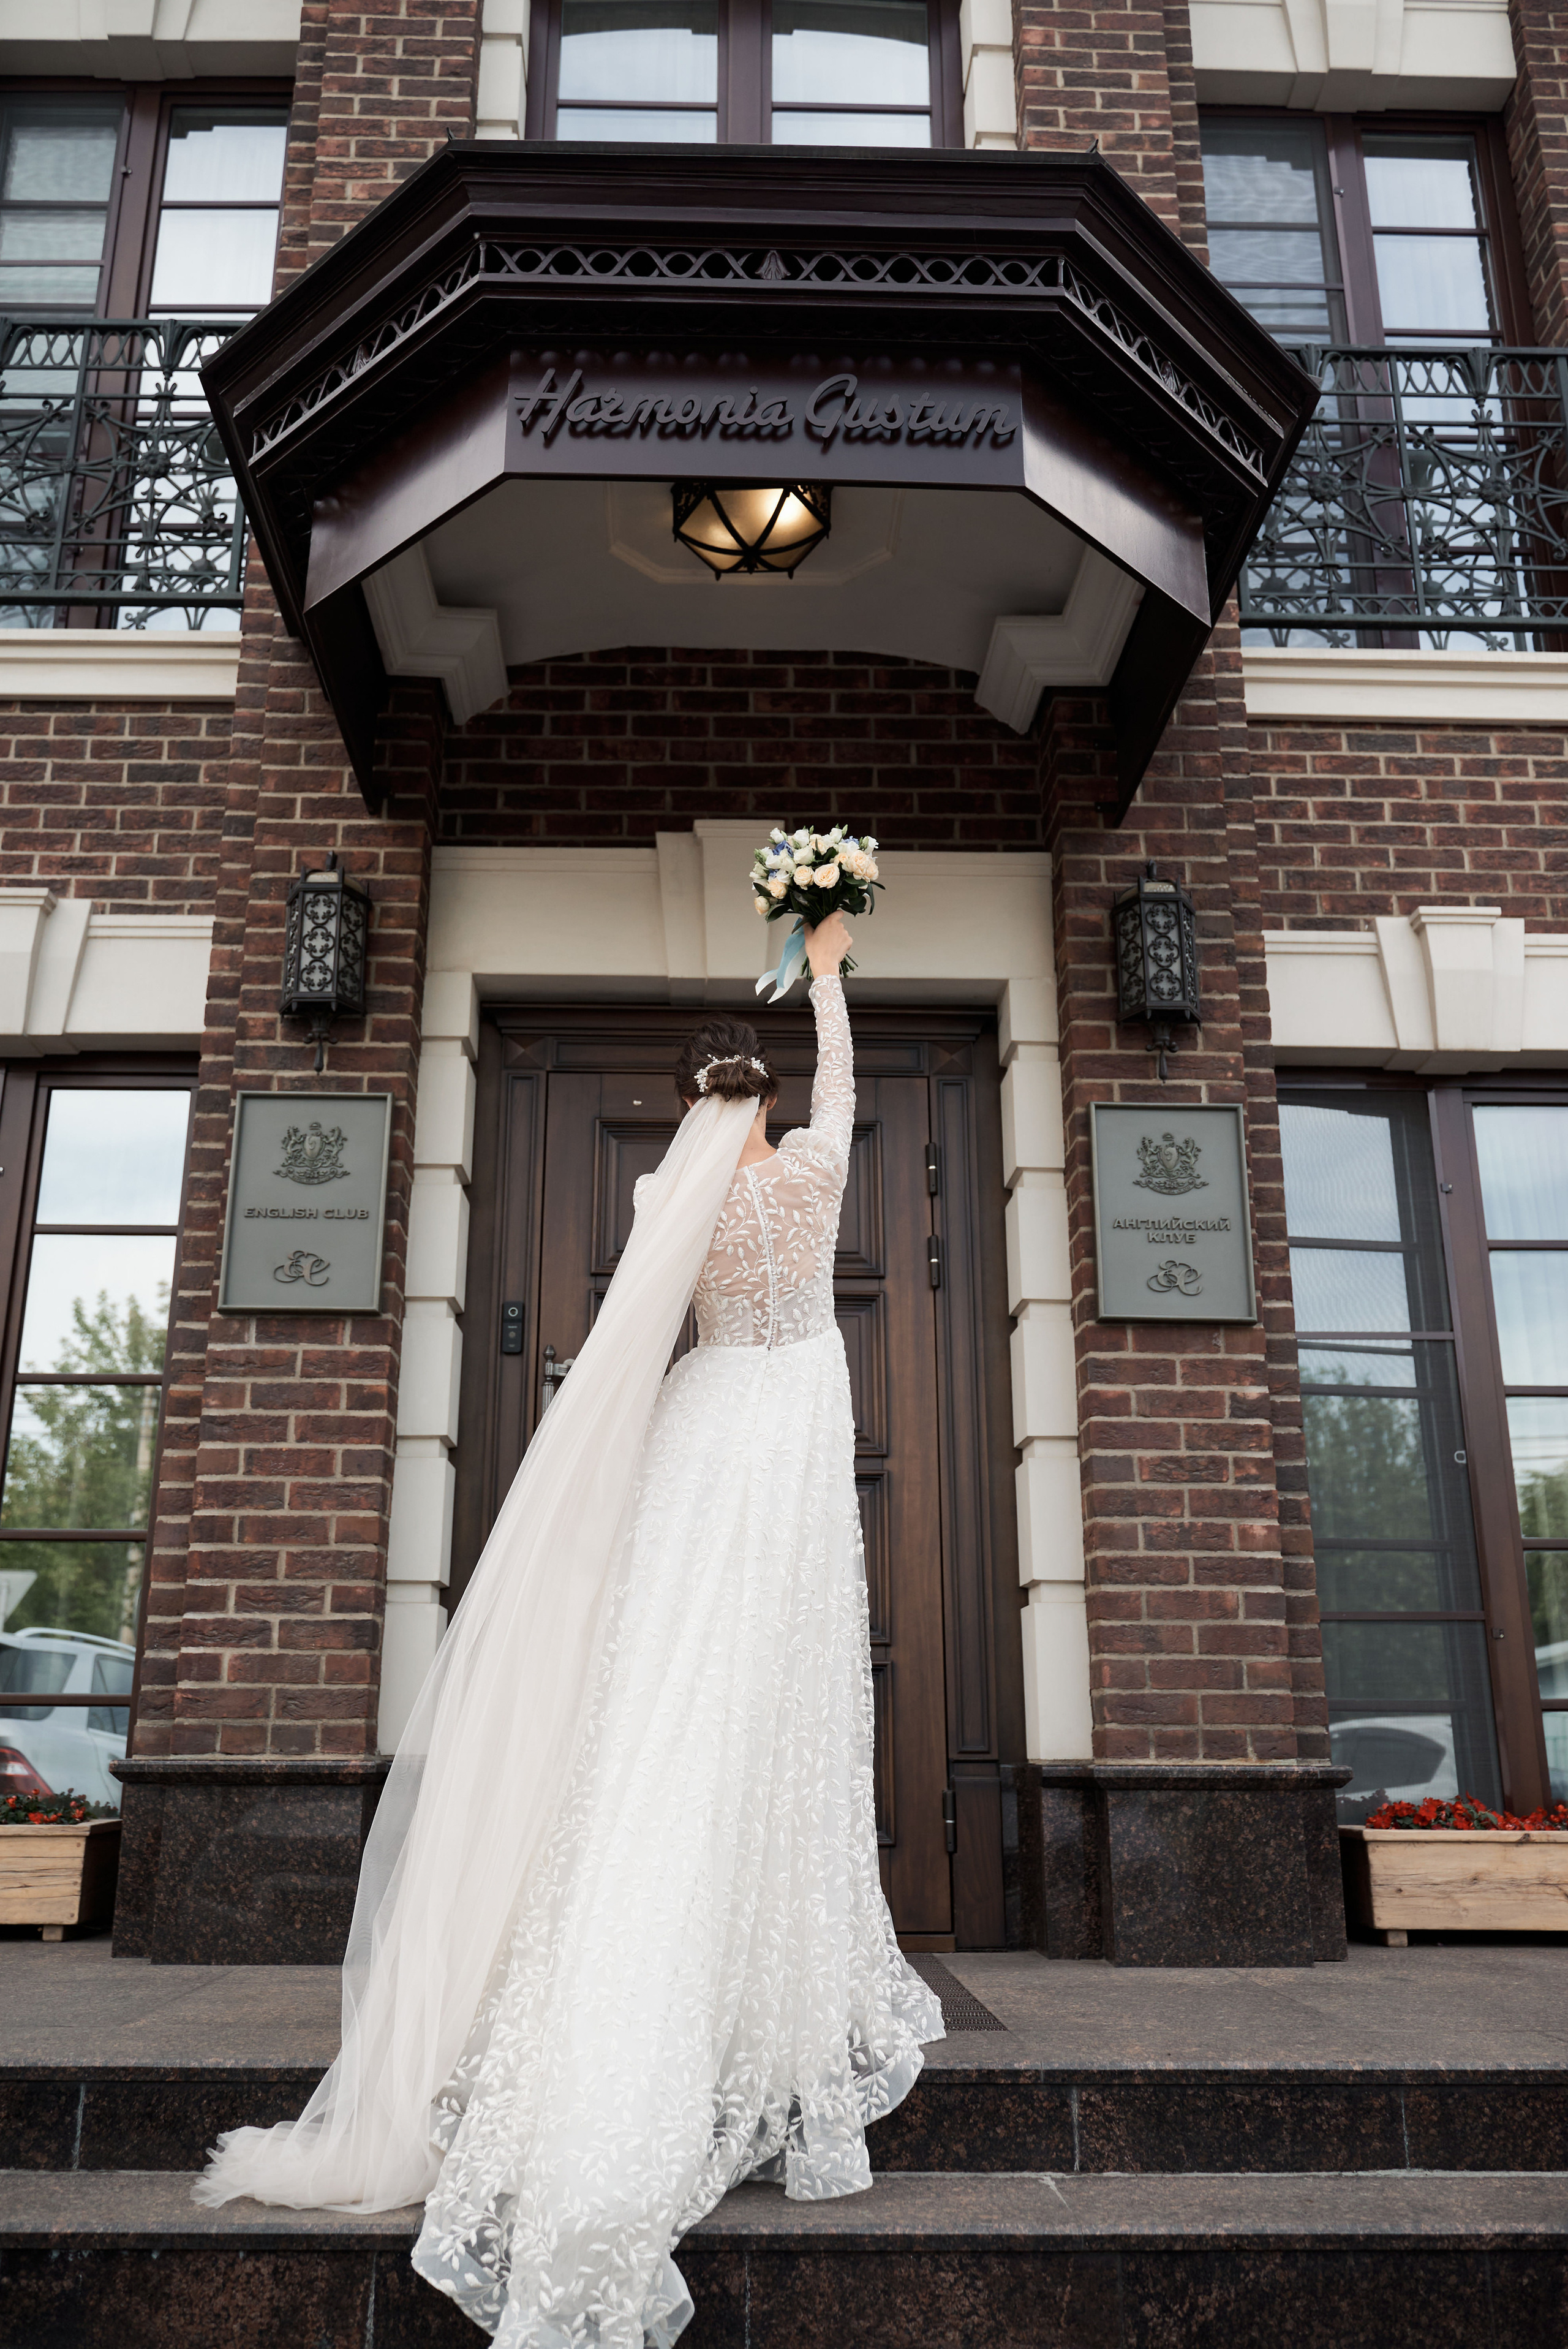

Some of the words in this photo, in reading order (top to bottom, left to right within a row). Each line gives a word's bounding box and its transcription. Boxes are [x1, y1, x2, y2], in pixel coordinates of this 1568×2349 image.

[514, 368, 795, 434] Harmonia
[805, 374, 1018, 438] Gustum
[244, 1207, 318, 1219] ENGLISH
[322, 1208, 369, 1219] CLUB
[1113, 1216, 1231, 1230] АНГЛИЙСКИЙ
[1148, 1231, 1197, 1244] КЛУБ
